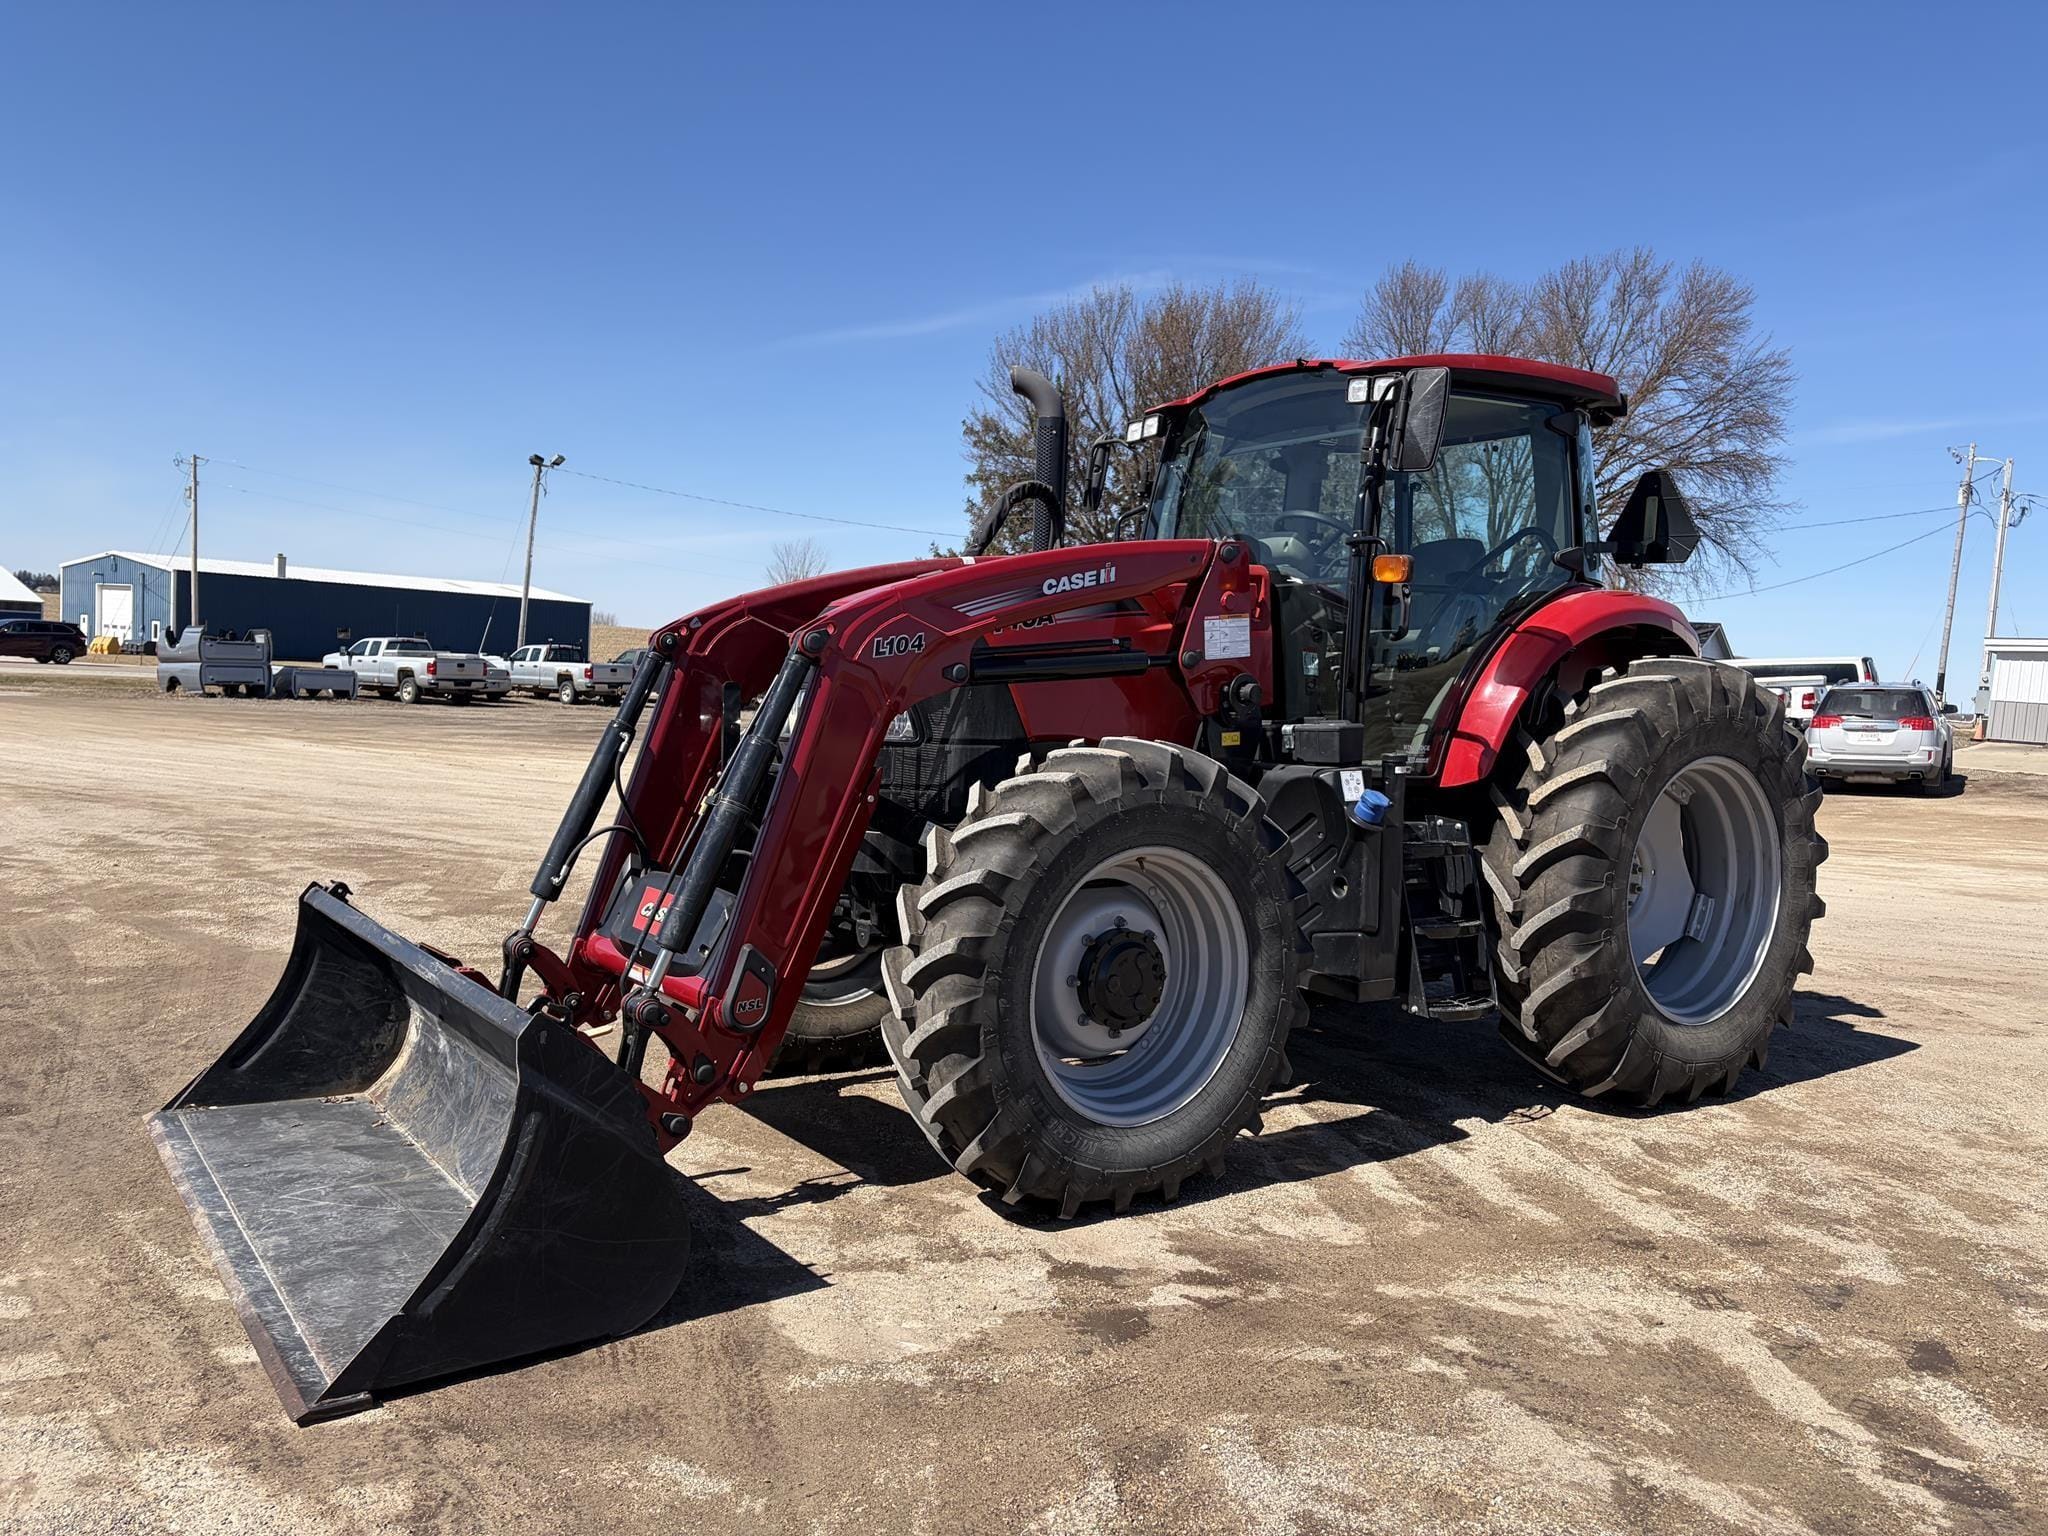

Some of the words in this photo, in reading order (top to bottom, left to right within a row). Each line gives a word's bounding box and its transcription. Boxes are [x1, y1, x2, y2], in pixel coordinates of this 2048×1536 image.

[1042, 570, 1097, 595] CASE
[873, 632, 925, 658] L104
[736, 998, 764, 1013] NSL
